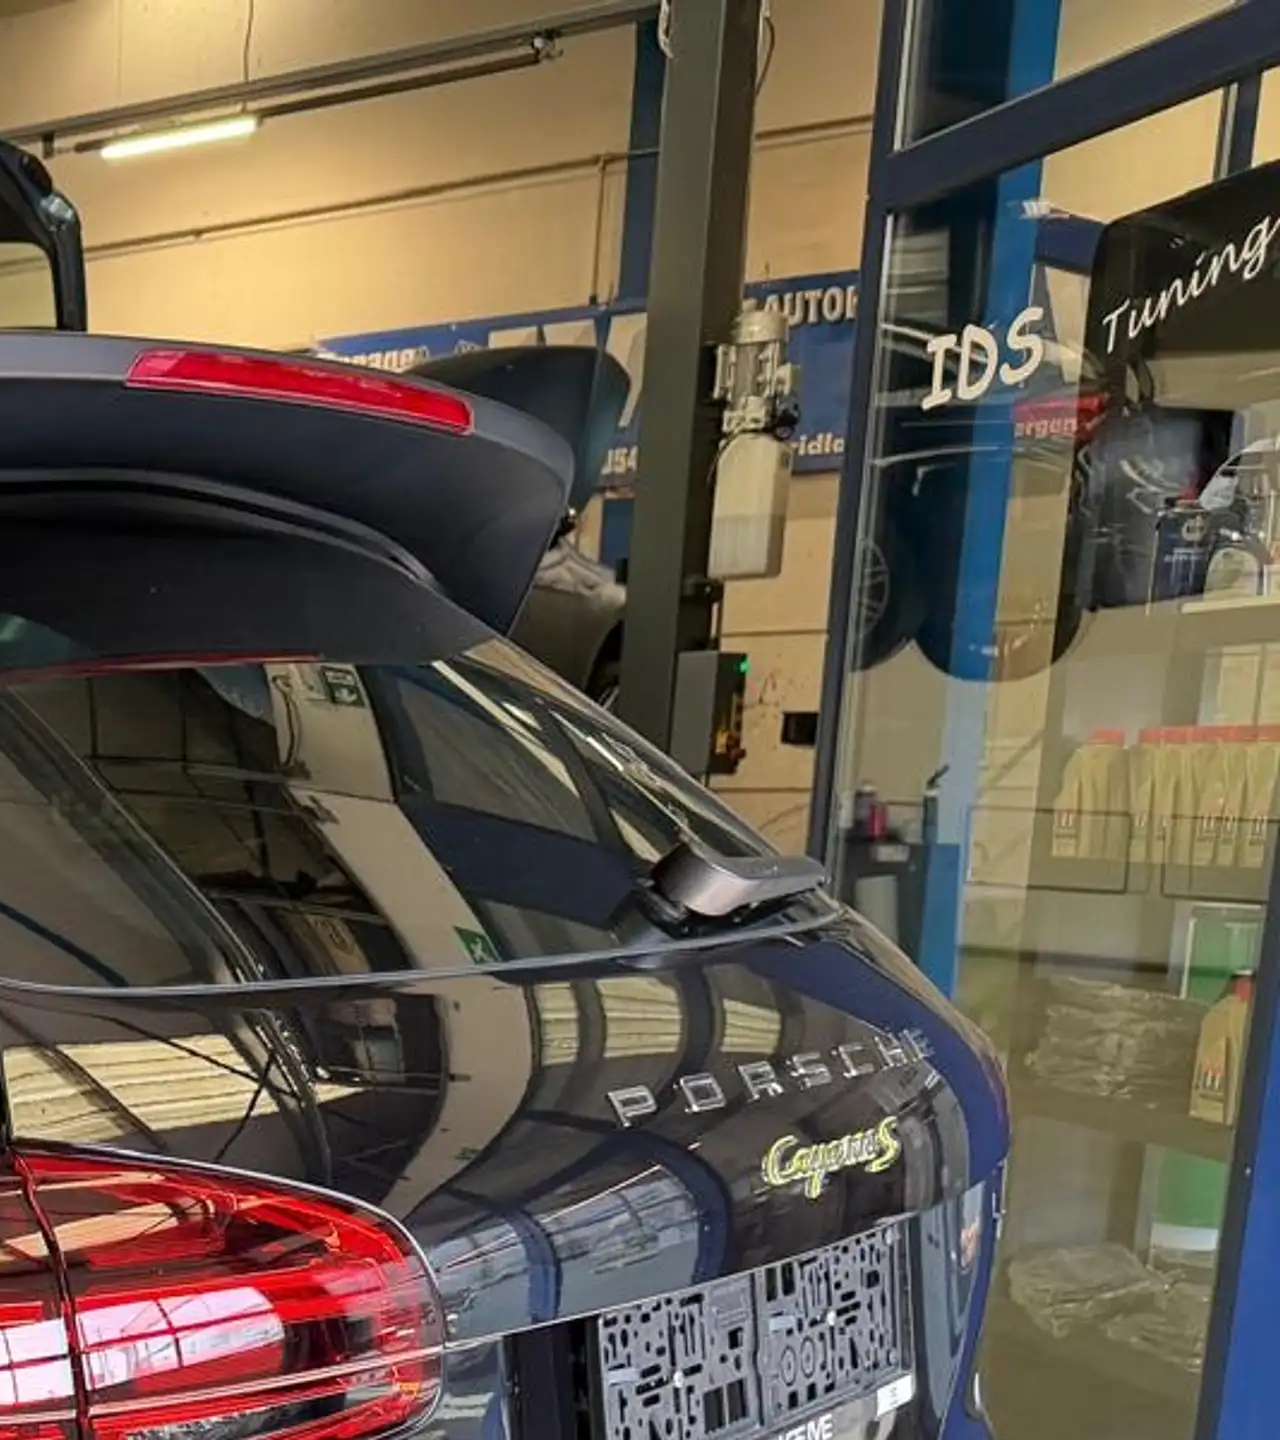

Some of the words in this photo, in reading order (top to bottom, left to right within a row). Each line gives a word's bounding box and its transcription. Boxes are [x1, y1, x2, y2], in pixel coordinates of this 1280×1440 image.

[1102, 214, 1280, 354] Tuning
[920, 305, 1045, 412] IDS
[607, 1026, 932, 1129] PORSCHE
